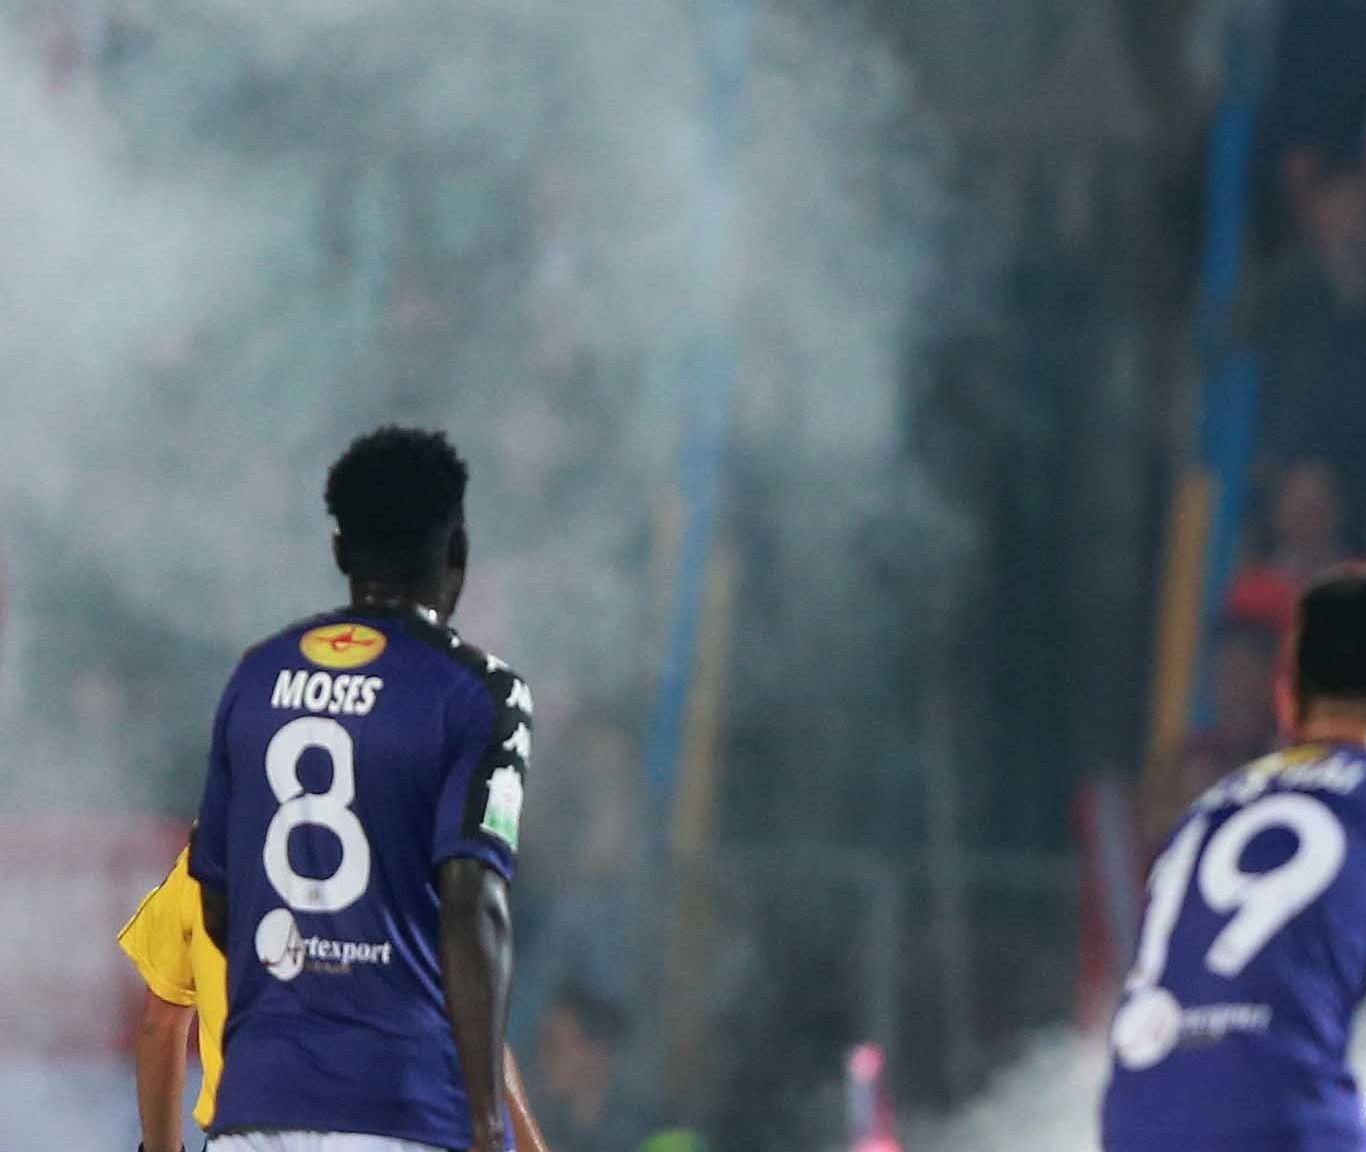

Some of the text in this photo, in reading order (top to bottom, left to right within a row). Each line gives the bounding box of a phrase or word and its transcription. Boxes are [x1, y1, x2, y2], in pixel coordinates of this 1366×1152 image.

[271, 669, 384, 716] MOSES
[263, 716, 371, 913] 8
[1126, 792, 1347, 990] 19
